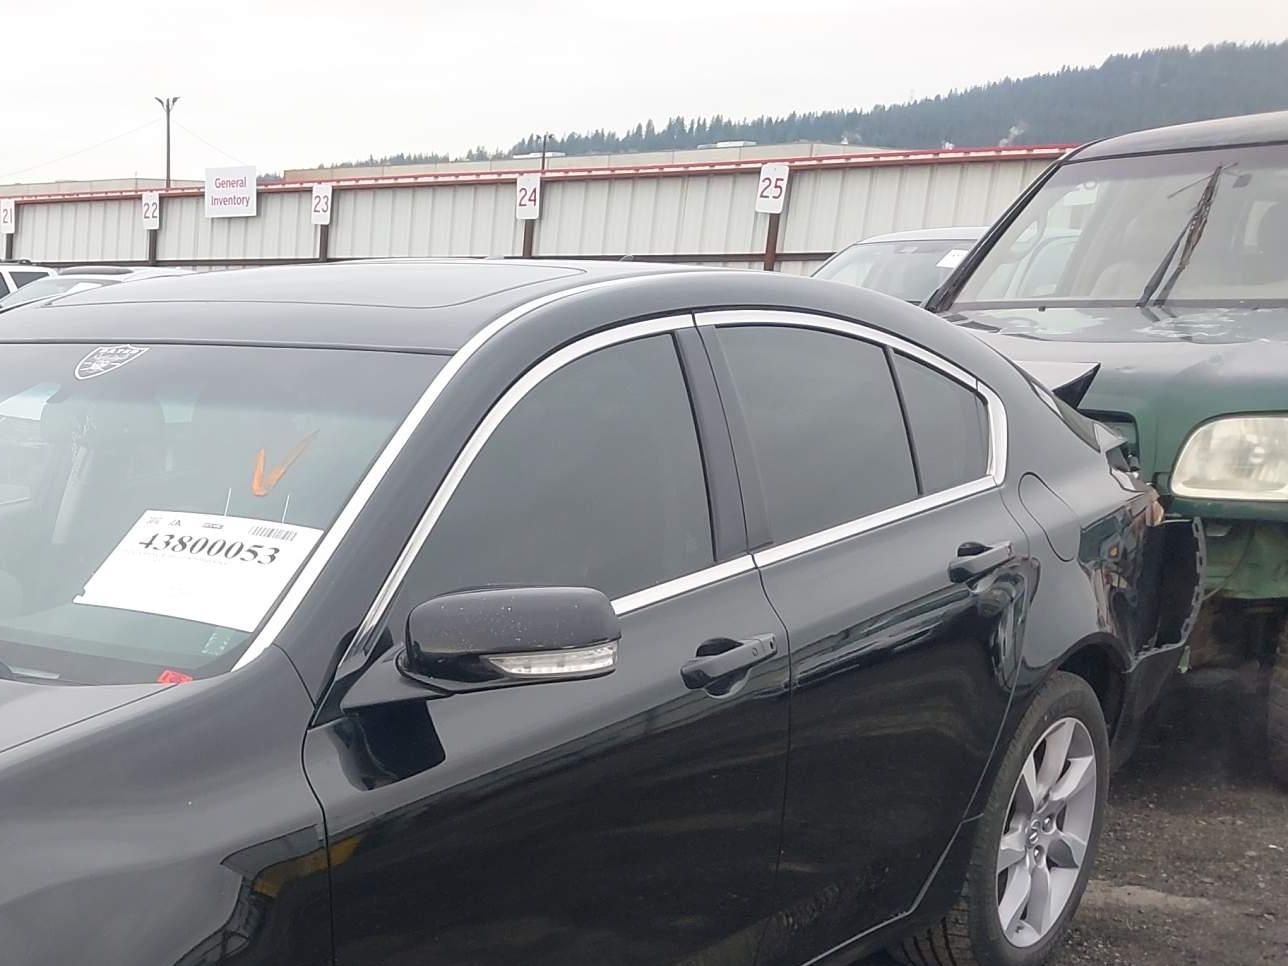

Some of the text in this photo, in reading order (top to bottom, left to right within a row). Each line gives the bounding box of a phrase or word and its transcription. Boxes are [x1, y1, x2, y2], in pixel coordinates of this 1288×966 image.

[214, 175, 247, 189] General
[759, 177, 784, 199] 25
[211, 194, 250, 207] Inventory
[313, 194, 330, 213] 23
[518, 187, 537, 206] 24
[2, 207, 13, 224] 21
[143, 201, 158, 219] 22
[138, 532, 281, 565] 43800053
